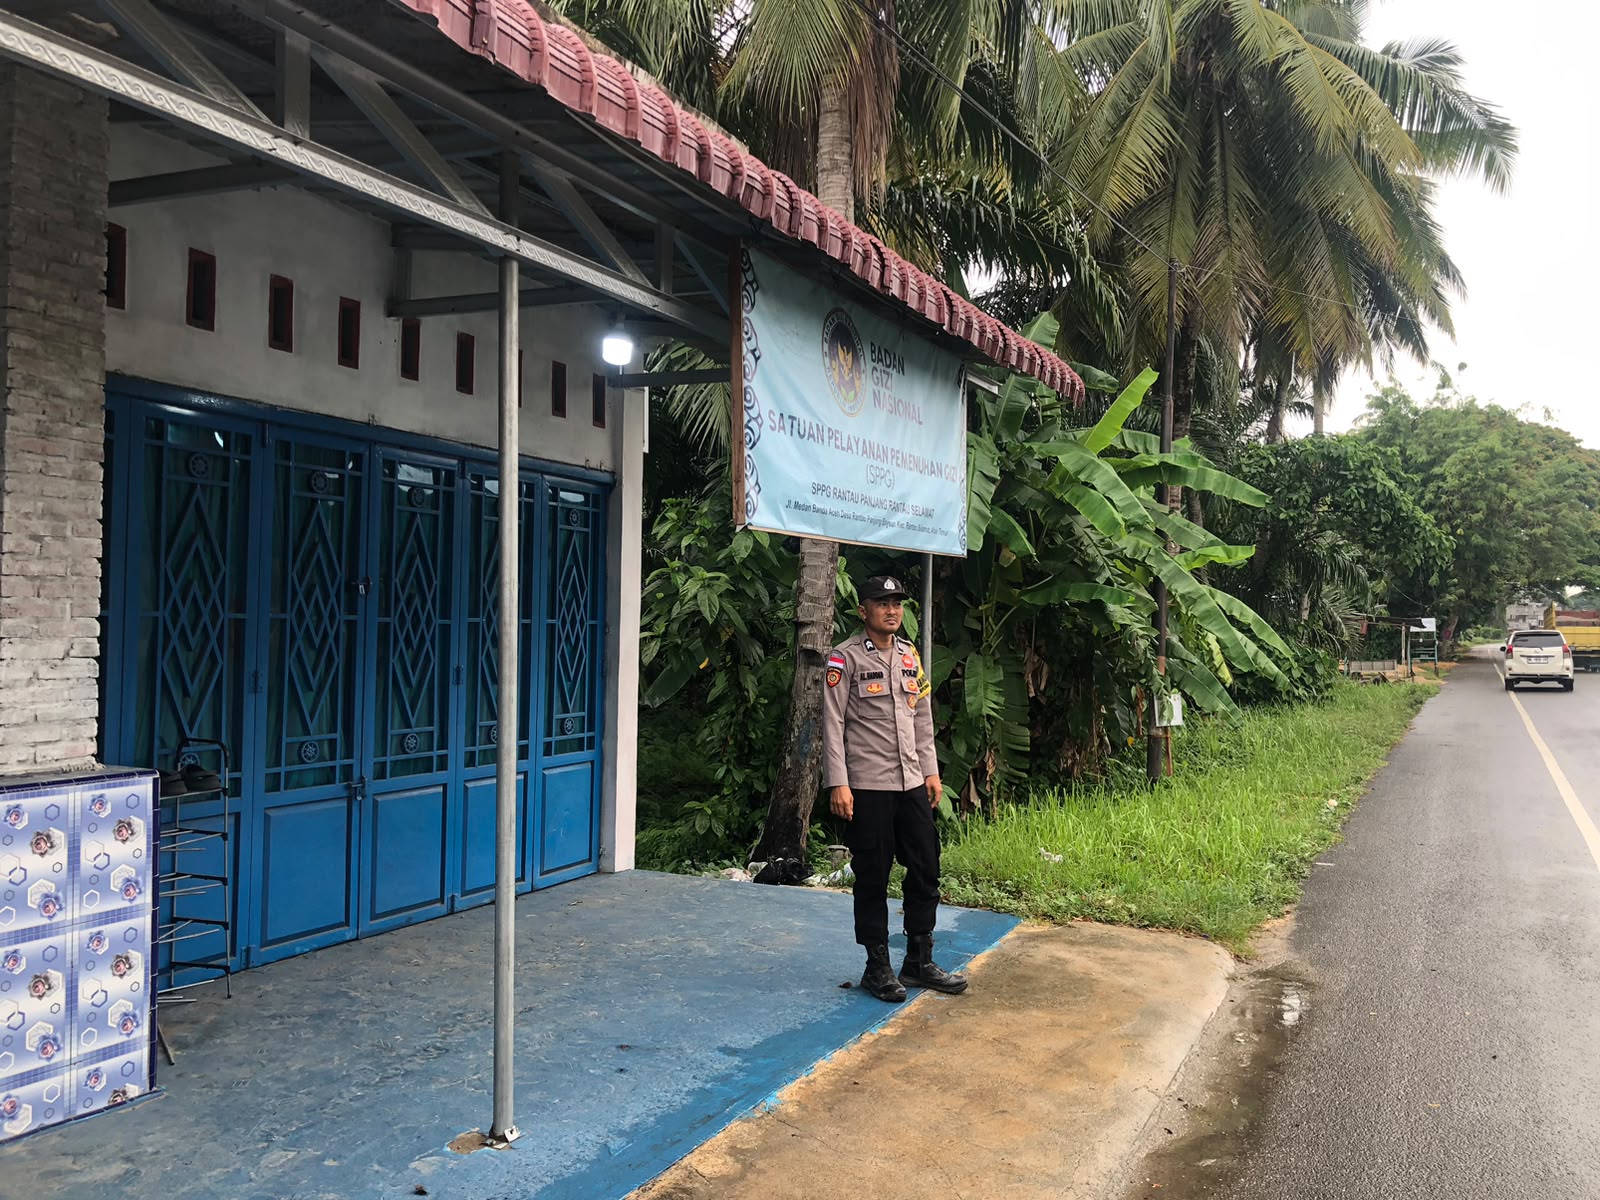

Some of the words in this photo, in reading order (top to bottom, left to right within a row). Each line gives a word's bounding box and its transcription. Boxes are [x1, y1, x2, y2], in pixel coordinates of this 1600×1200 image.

[870, 341, 905, 376] BADAN
[872, 366, 892, 392] GIZI
[873, 388, 922, 425] NASIONAL
[768, 409, 824, 445] SATUAN
[828, 427, 889, 464] PELAYANAN
[890, 447, 942, 479] PEMENUHAN
[944, 464, 959, 483] GIZI
[866, 463, 895, 490] (SPPG)
[793, 500, 812, 512] Medan
[812, 504, 828, 515] Banda
[829, 508, 840, 517] Aceh
[840, 510, 852, 519] Desa
[812, 482, 831, 498] SPPG
[833, 487, 860, 504] RANTAU
[861, 494, 888, 510] PANJANG
[888, 500, 910, 515] RANTAU
[911, 504, 935, 518] SELAMAT
